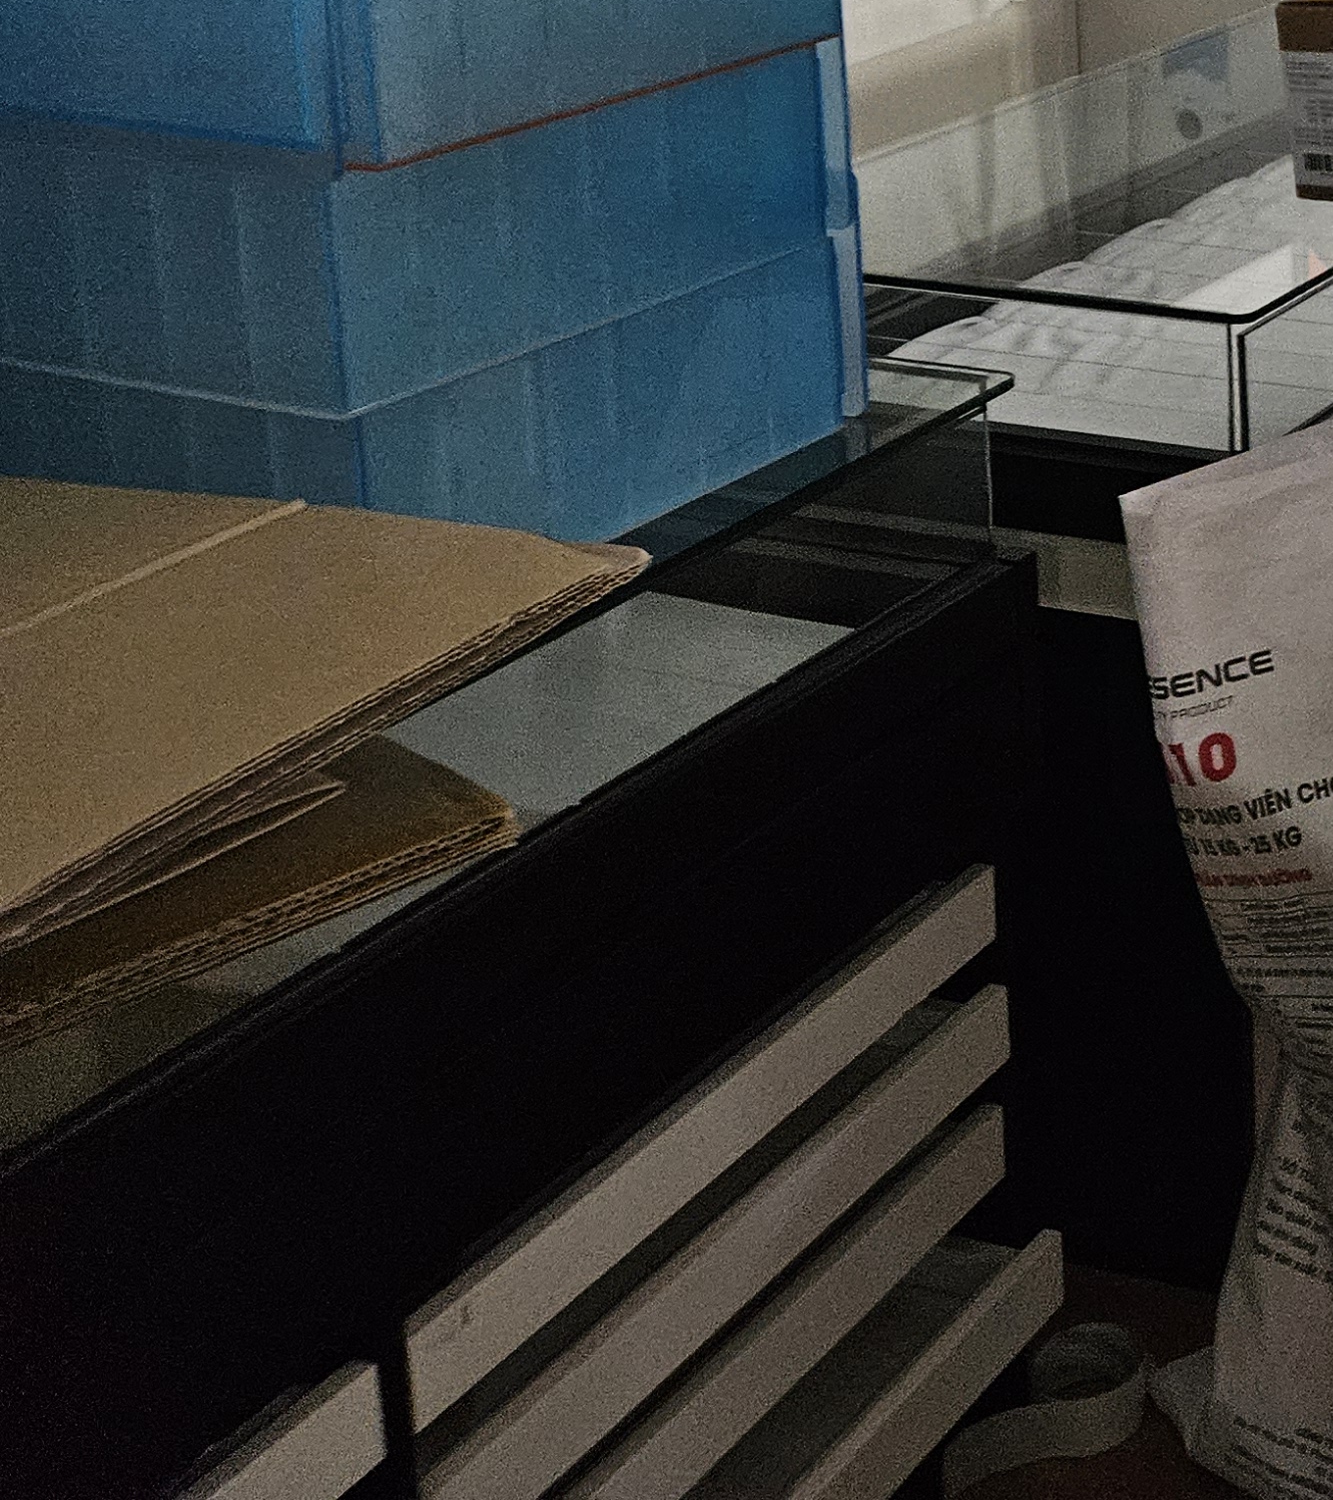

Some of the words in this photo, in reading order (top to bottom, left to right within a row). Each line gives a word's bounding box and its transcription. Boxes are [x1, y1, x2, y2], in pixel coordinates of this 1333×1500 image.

[1149, 649, 1275, 700] SENCE
[1246, 789, 1293, 821] VIÊN
[1274, 825, 1304, 850] KG
